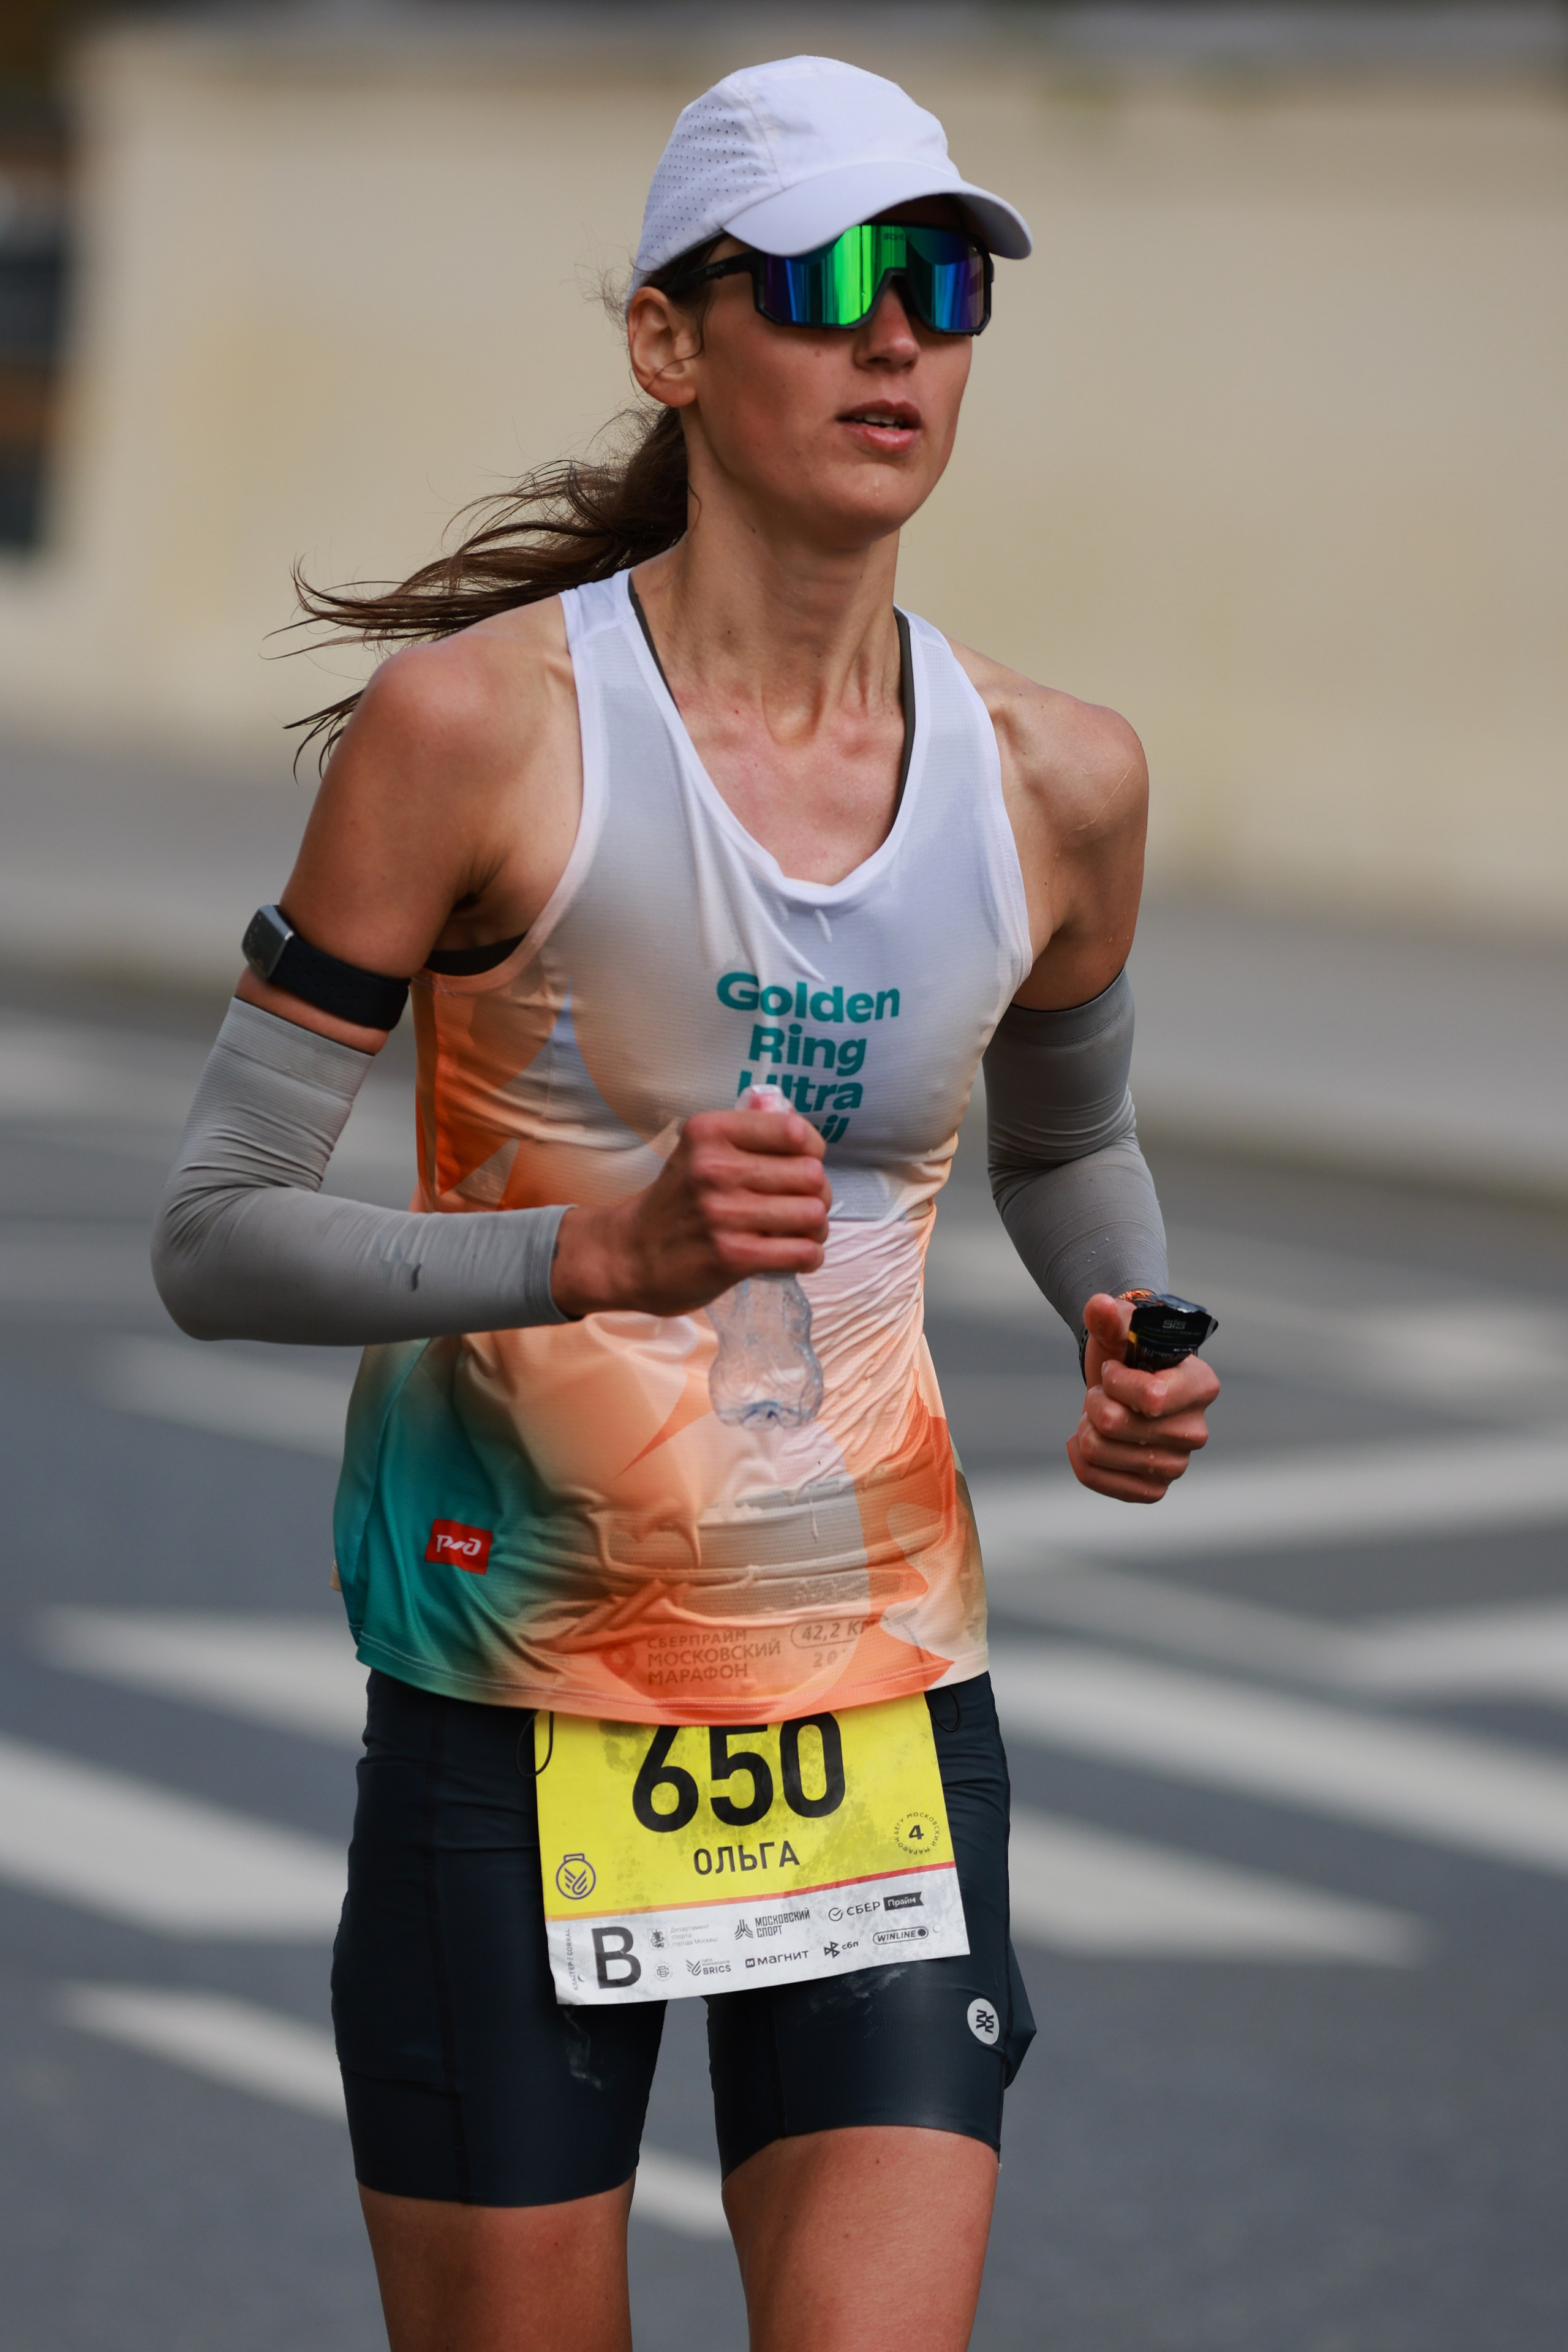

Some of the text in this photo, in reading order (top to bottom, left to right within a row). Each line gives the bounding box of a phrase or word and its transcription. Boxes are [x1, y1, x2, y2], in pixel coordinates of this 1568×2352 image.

[717, 971, 900, 1023] Golden
[748, 1023, 867, 1076] Ring
[647, 1629, 747, 1649] СБЕРПРАЙМ
[802, 1623, 840, 1642] 42,2
[648, 1638, 780, 1667] МОСКОВСКИЙ
[648, 1664, 747, 1686] МАРАФОН
[632, 1711, 845, 1832] 650
[907, 1812, 940, 1846] МОСКОВСКИЙ
[908, 1825, 924, 1840] 4
[895, 1837, 930, 1855] МАРАФОН
[694, 1841, 800, 1875] ОЛЬГА
[846, 1897, 916, 1916] СБЕР Прайм
[755, 1907, 810, 1927] МОСКОВСКИЙ
[670, 1924, 709, 1933] Департамент
[756, 1925, 782, 1938] СПОРТ
[878, 1931, 916, 1942] WINLINE
[703, 1965, 731, 1975] BRICS
